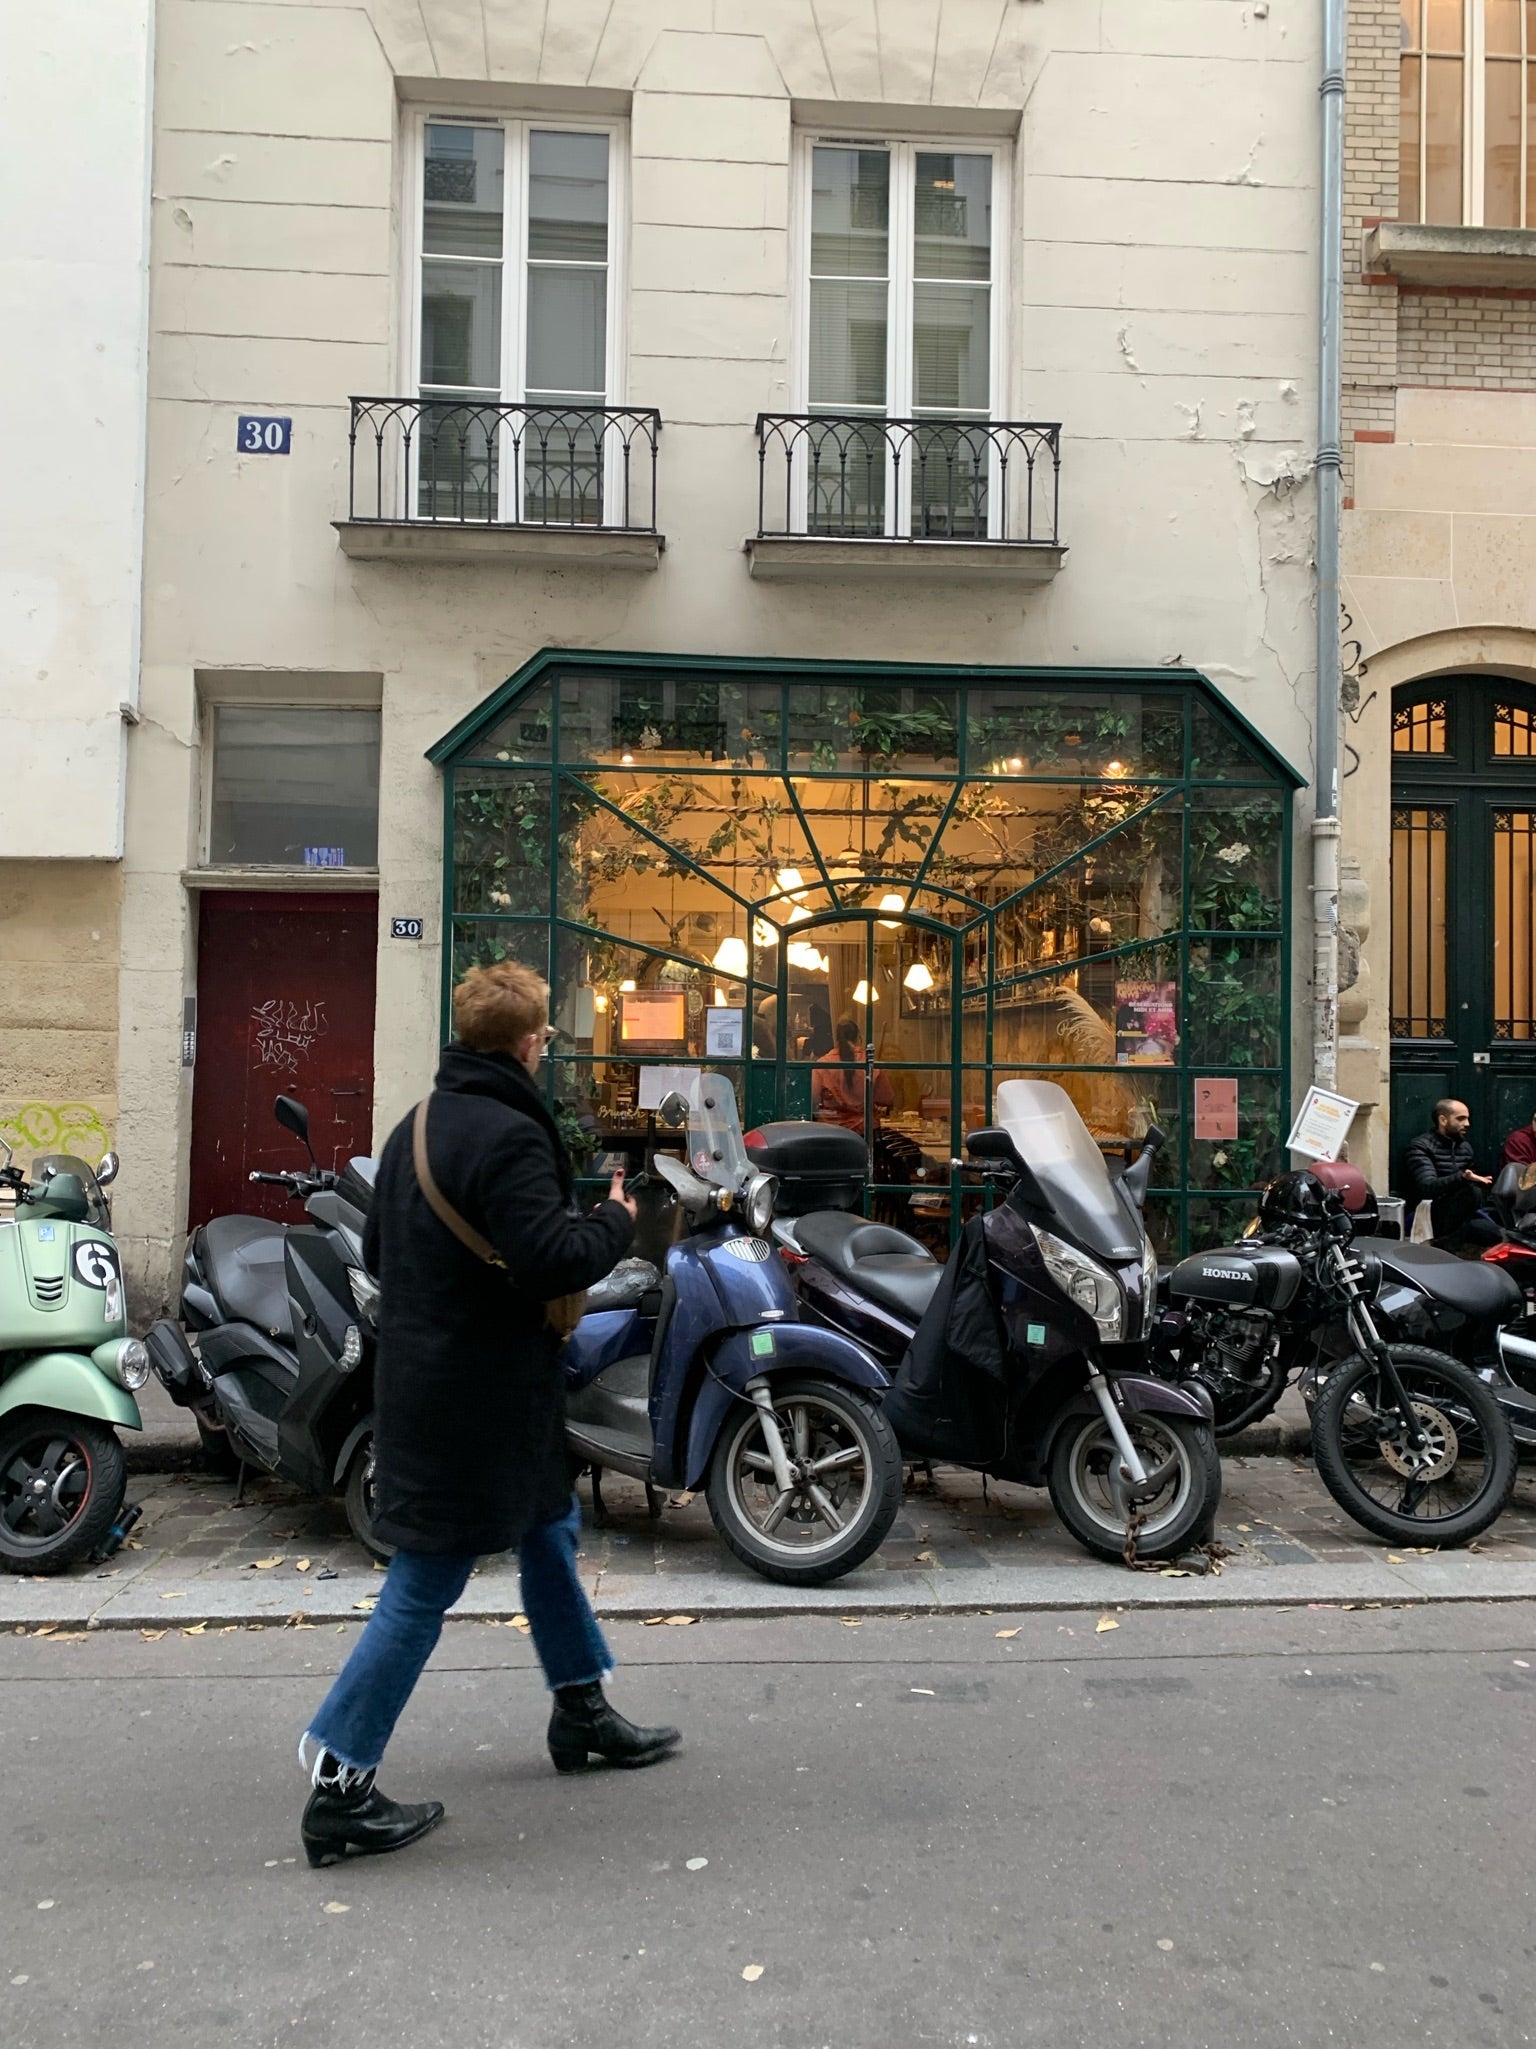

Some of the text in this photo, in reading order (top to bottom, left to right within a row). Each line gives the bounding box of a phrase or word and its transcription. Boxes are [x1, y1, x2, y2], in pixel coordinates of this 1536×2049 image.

[245, 421, 284, 450] 30
[395, 920, 419, 935] 30
[597, 1105, 644, 1118] Brunch
[76, 1243, 116, 1286] 6
[1202, 1267, 1253, 1281] HONDA
